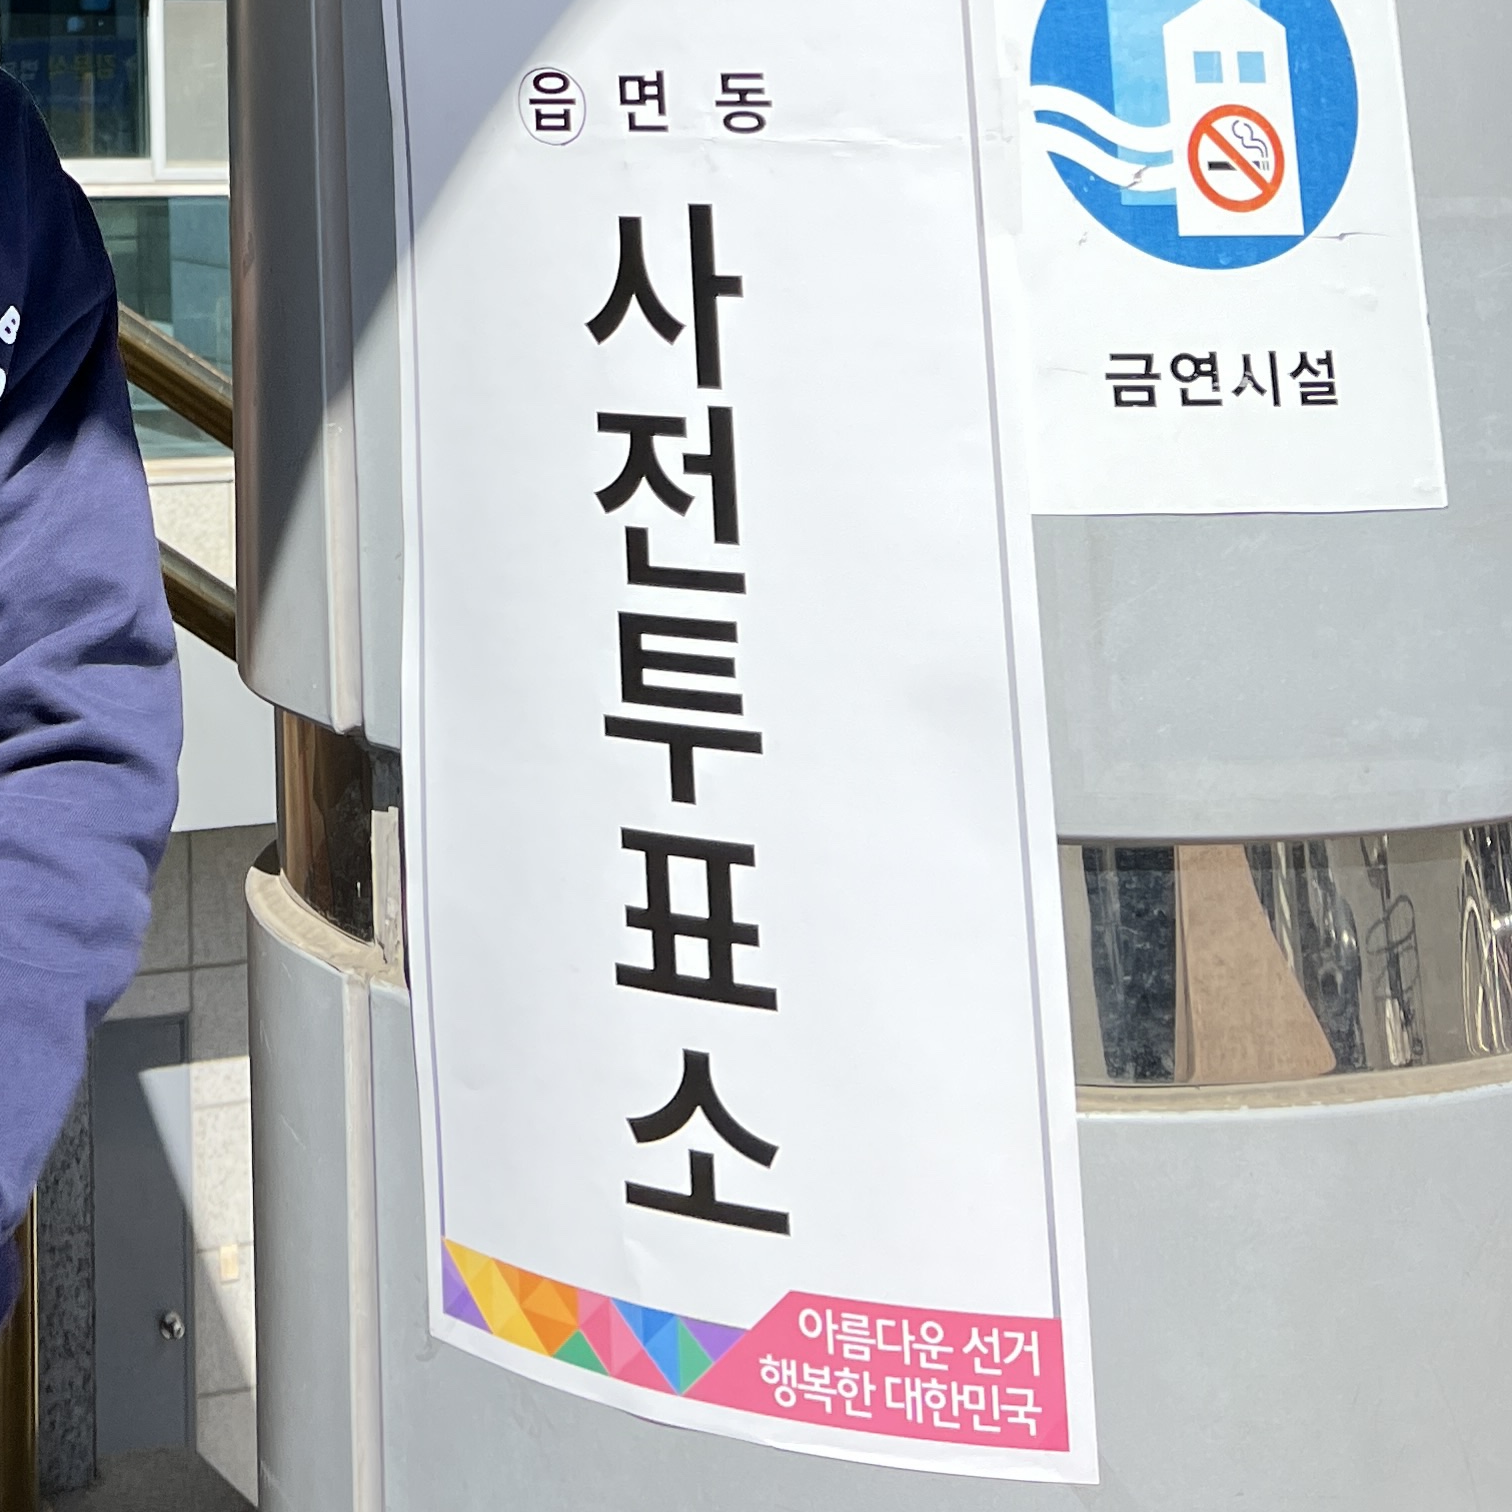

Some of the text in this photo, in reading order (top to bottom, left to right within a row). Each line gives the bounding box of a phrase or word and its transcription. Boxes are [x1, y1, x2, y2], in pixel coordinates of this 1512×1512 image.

[528, 70, 773, 135] 읍 면 동
[1104, 349, 1340, 408] 금연시설
[584, 202, 792, 1238] 사전투표소
[798, 1307, 1041, 1377] 아름다운 선거
[759, 1353, 1043, 1437] 행복한 대한민국
